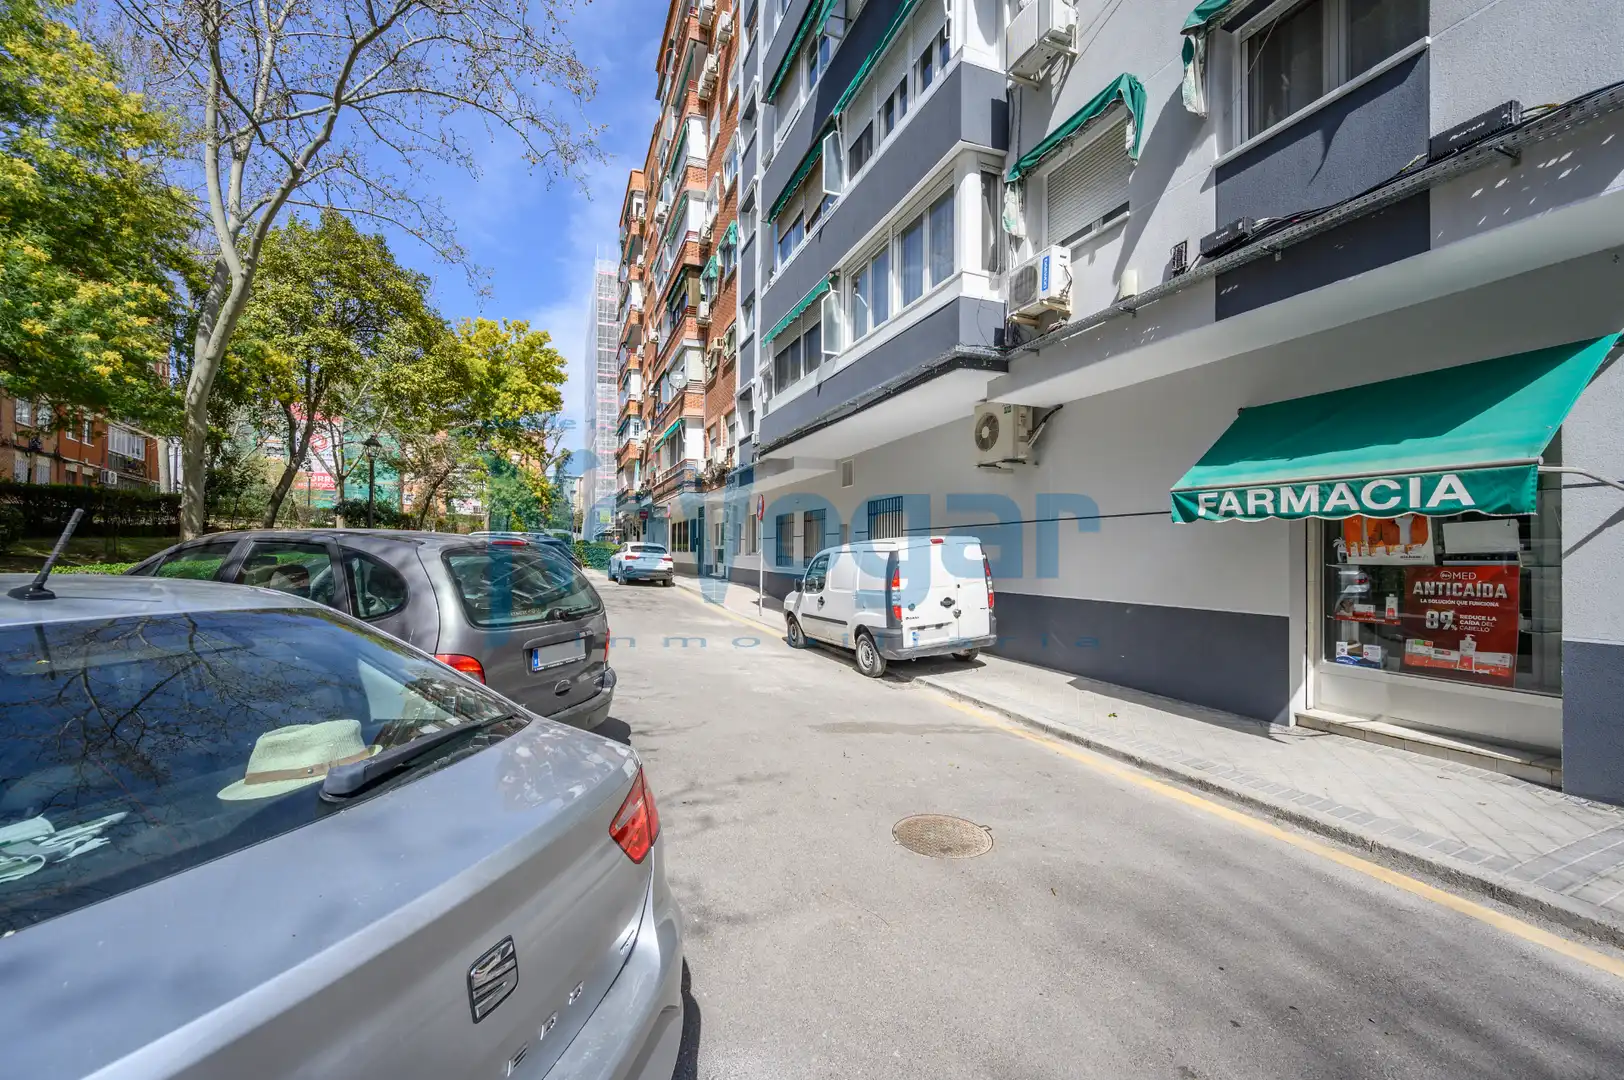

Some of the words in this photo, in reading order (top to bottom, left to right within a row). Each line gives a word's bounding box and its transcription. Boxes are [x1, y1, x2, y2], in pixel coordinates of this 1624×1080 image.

[1198, 474, 1476, 516] FARMACIA
[1452, 571, 1477, 580] MED
[1412, 580, 1508, 599] ANTICAÍDA
[1428, 597, 1456, 605] SOLUCIÓN
[1468, 600, 1500, 608] FUNCIONA
[1459, 625, 1491, 633] CABELLO
